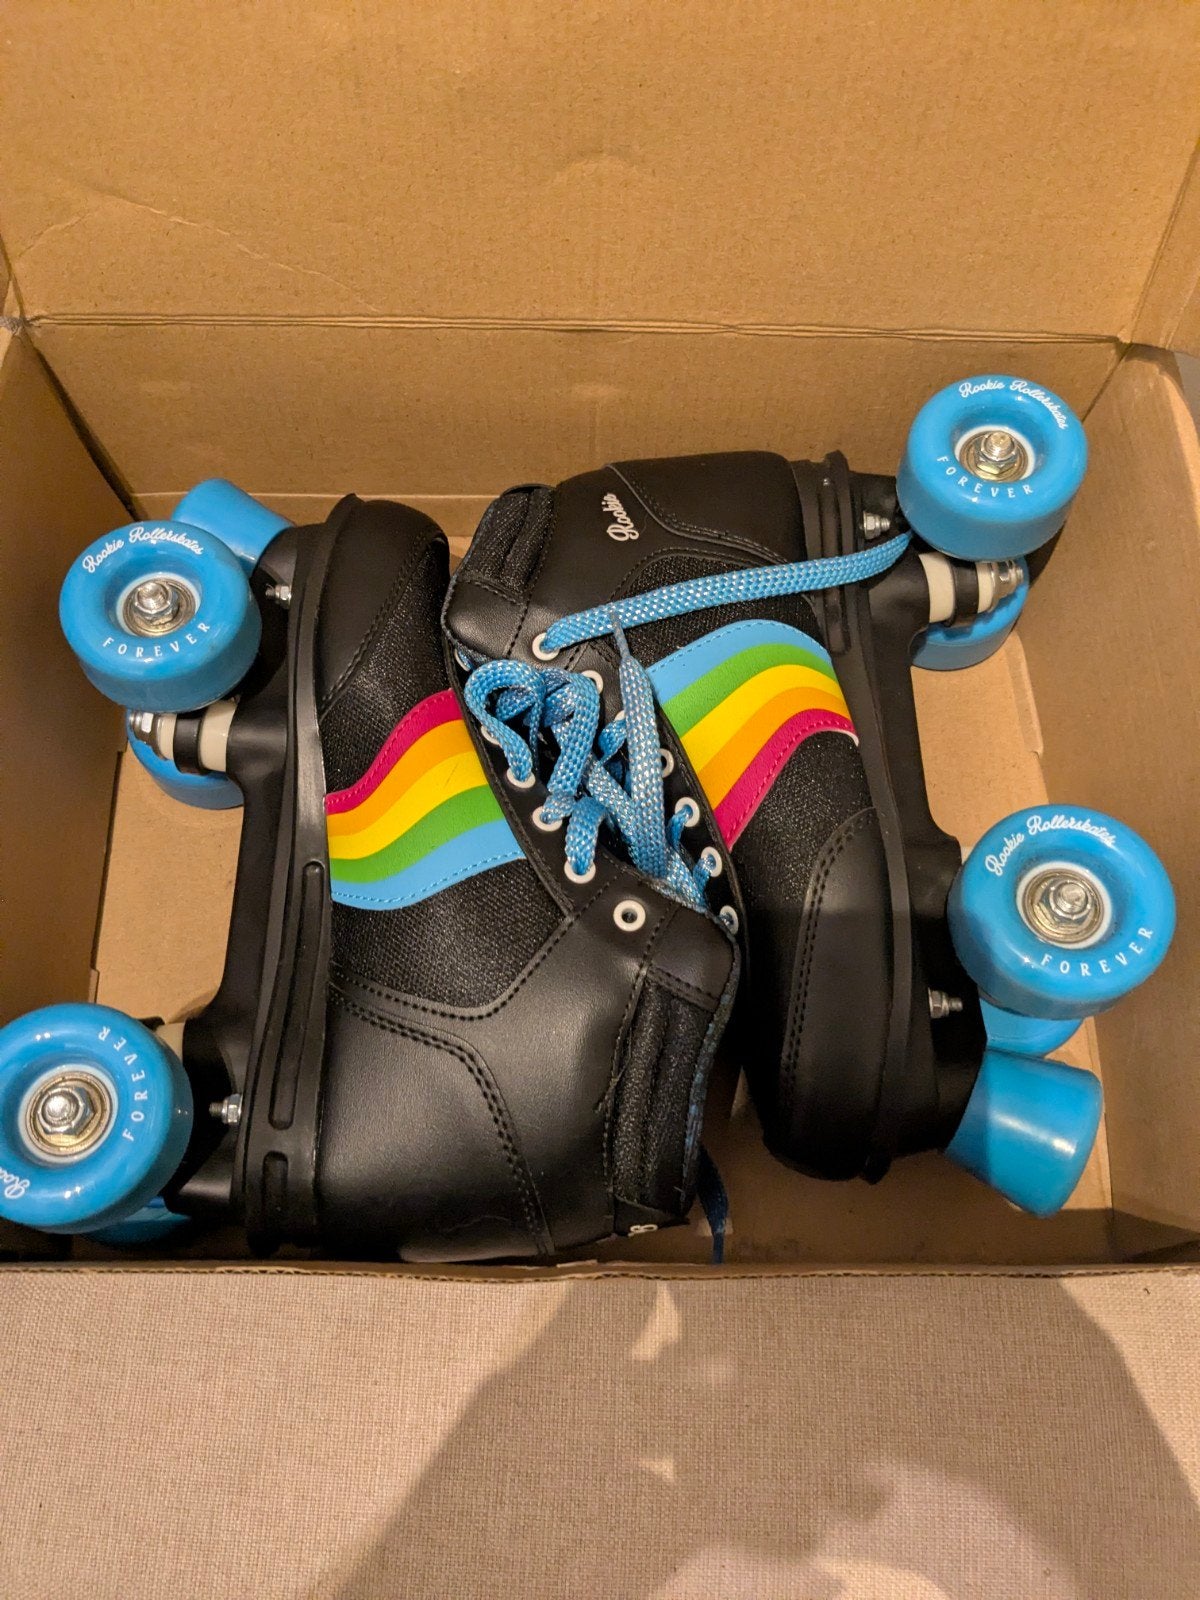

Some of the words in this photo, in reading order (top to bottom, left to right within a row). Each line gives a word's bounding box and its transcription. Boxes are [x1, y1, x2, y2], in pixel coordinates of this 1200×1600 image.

[959, 379, 1005, 398] Rookie
[1010, 379, 1068, 430] Rollerskates
[937, 455, 1034, 498] FOREVER
[601, 492, 640, 541] Rookie
[82, 538, 125, 573] Rookie
[129, 526, 203, 555] Rollerskates
[102, 622, 210, 658] FOREVER
[985, 832, 1025, 876] Rookie
[1026, 814, 1118, 848] Rollerskates
[1040, 926, 1154, 977] FOREVER
[98, 1026, 149, 1142] FOREVER
[0, 1166, 31, 1199] Roo
